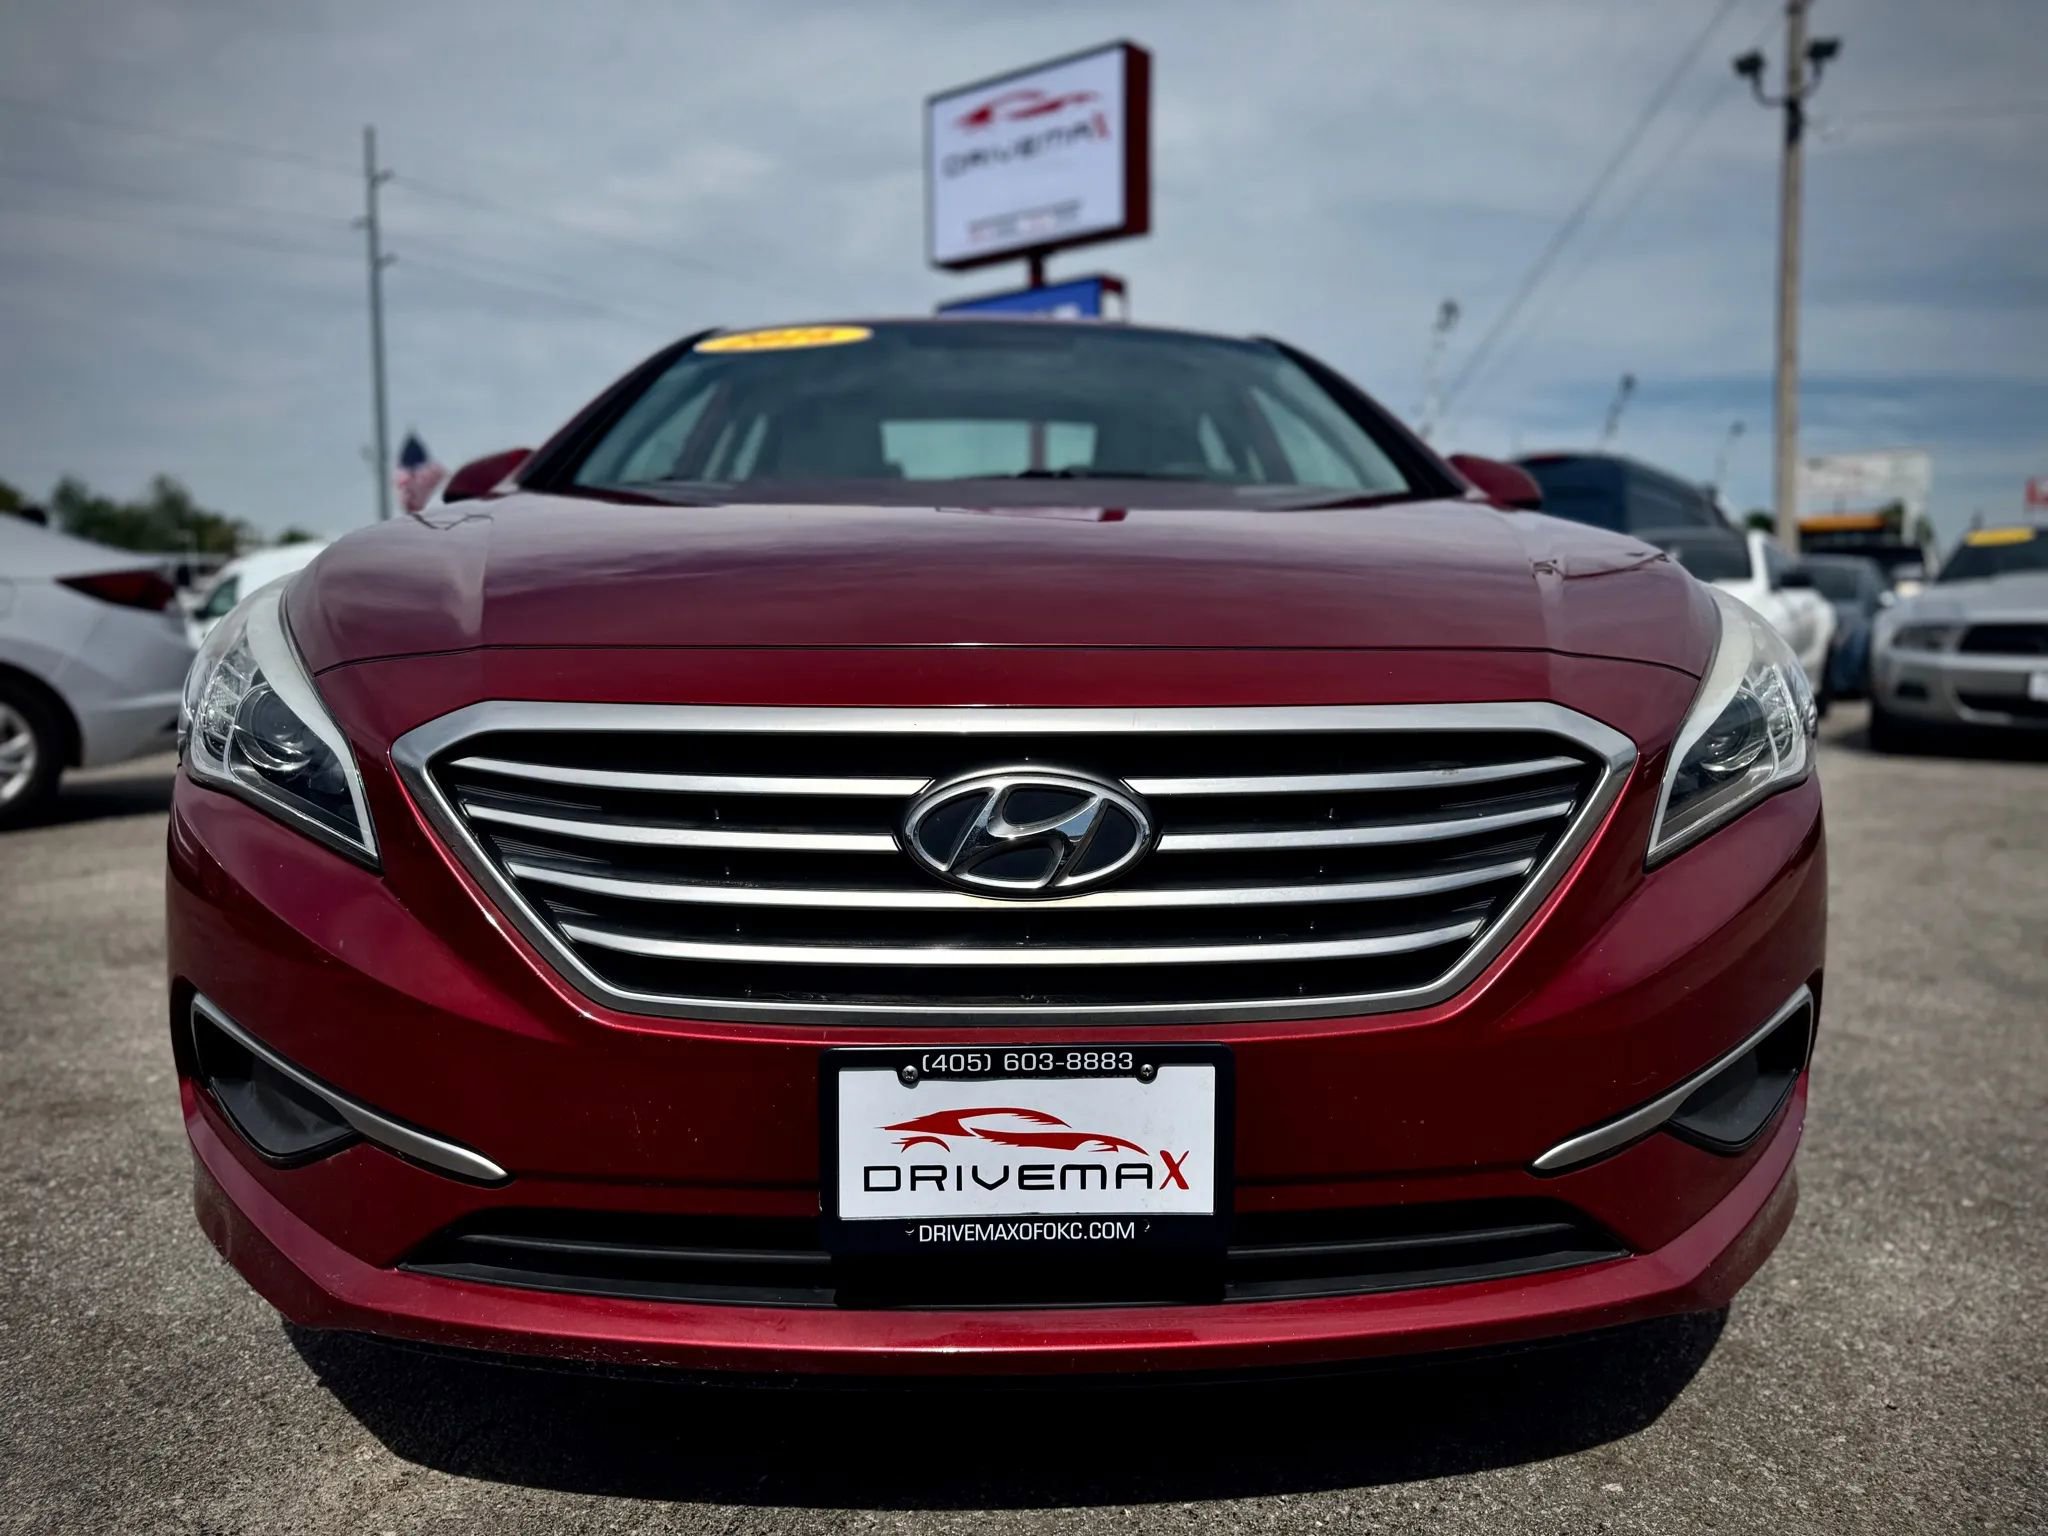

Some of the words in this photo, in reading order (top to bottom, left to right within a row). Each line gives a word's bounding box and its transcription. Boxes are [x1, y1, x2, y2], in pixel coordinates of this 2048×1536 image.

[922, 1053, 992, 1073] (405)
[1003, 1051, 1133, 1071] 603-8883
[863, 1150, 1190, 1192] DRIVEMAX
[919, 1221, 1135, 1243] DRIVEMAXOFOKC.COM
